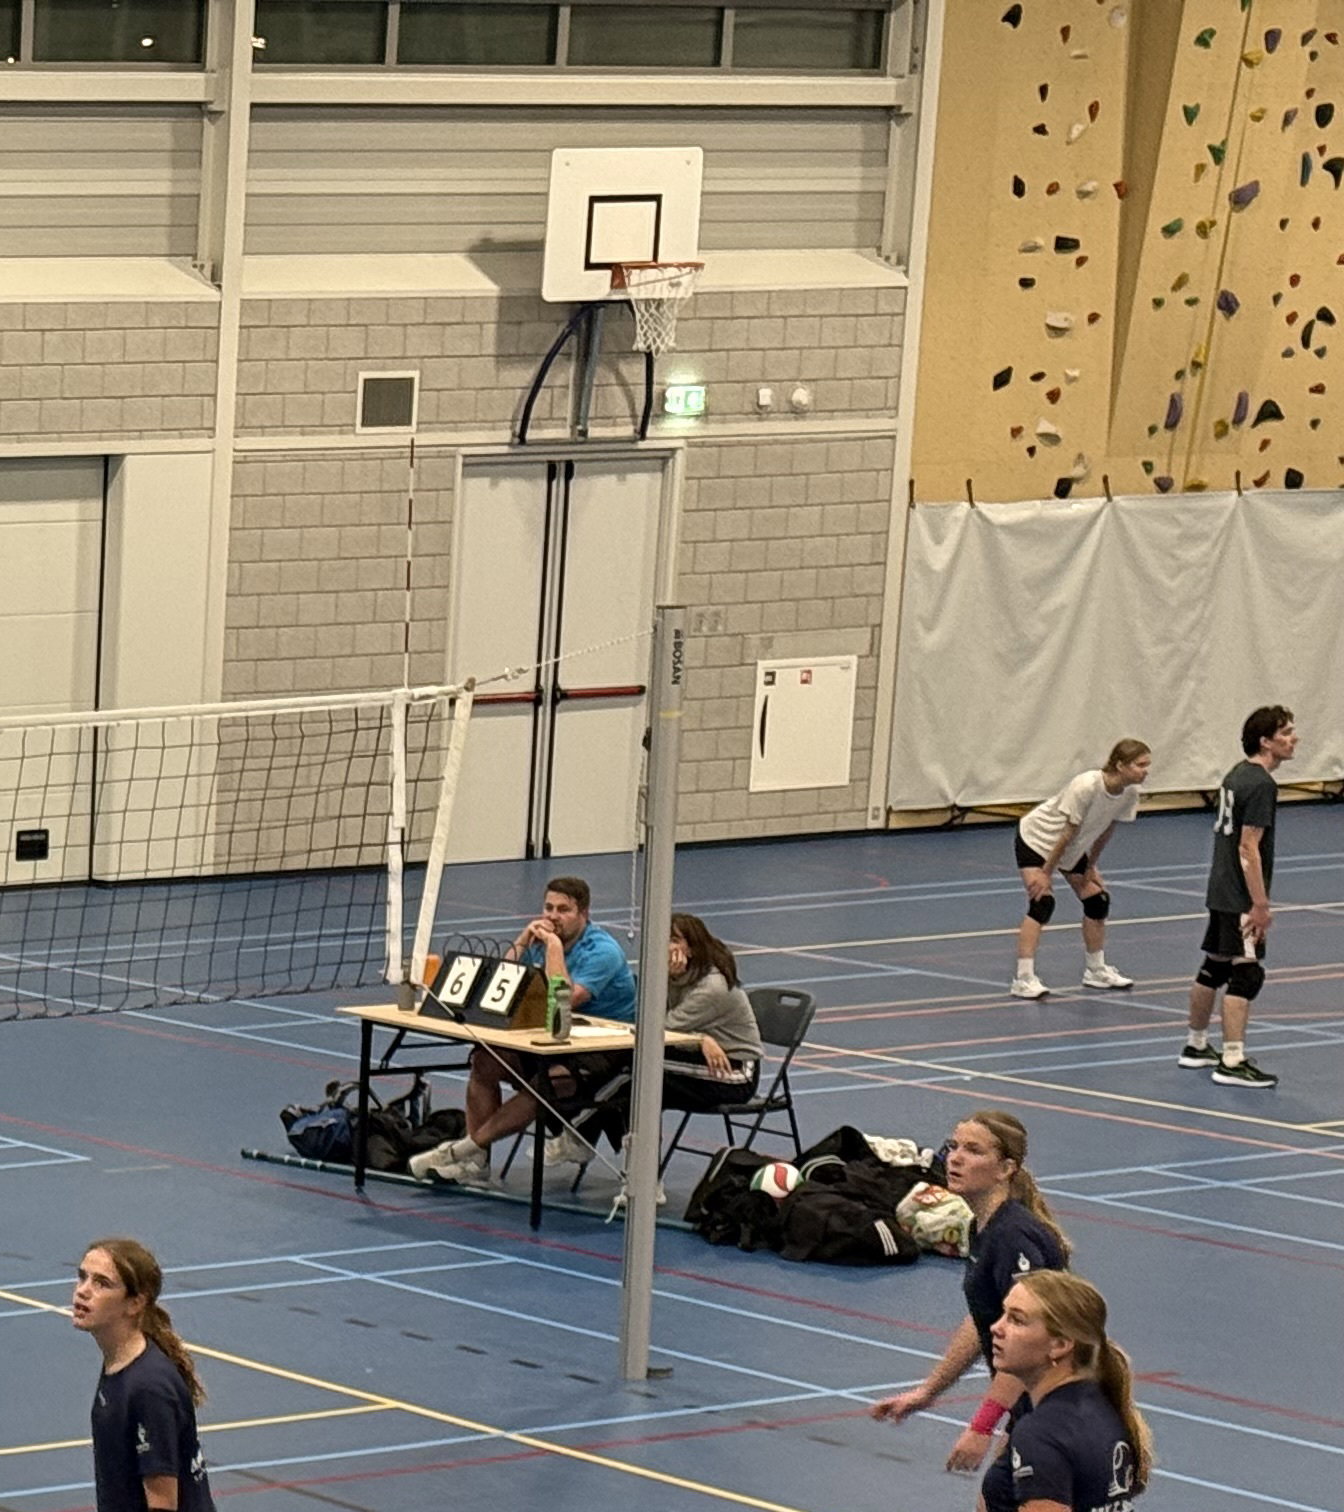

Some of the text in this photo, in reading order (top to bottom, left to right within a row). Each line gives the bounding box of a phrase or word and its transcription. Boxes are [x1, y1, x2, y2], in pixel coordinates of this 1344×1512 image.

[671, 641, 683, 685] BOSAN
[450, 972, 510, 1003] 6 5
